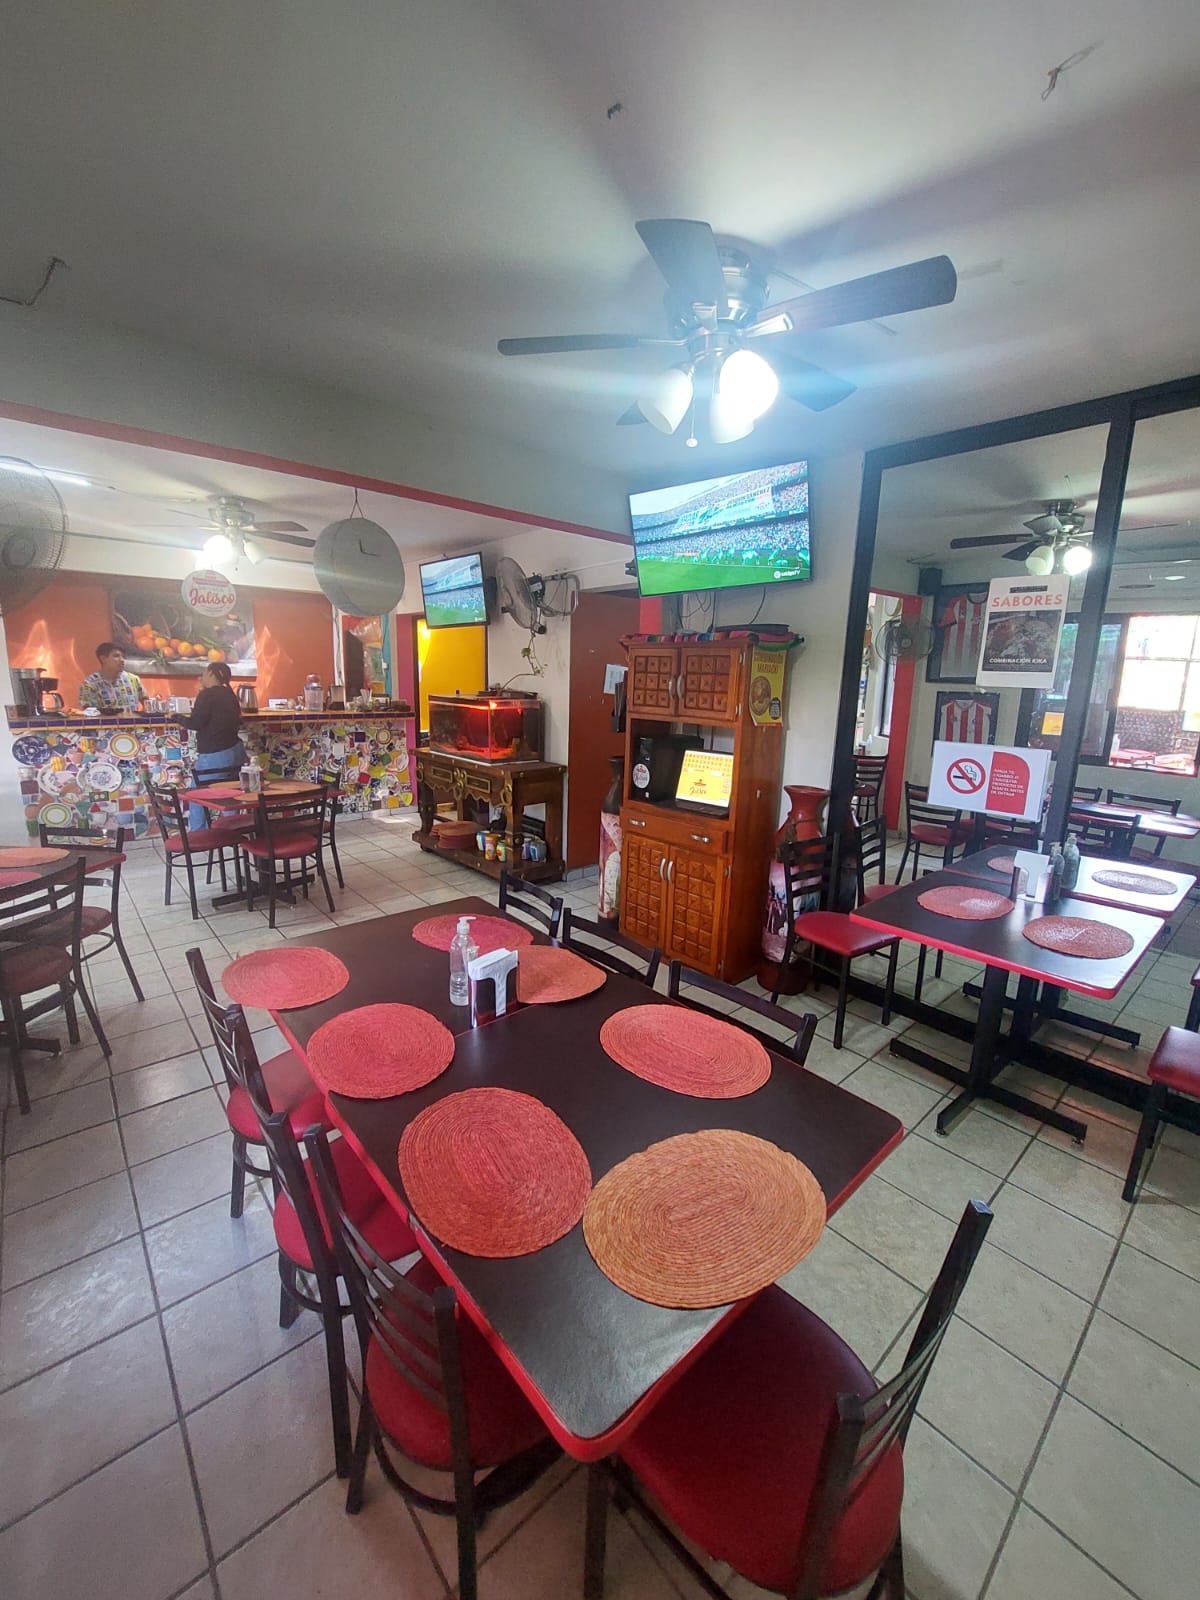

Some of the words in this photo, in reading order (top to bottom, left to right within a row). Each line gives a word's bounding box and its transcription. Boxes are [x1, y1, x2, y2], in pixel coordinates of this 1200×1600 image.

[189, 588, 234, 606] Jalisco
[991, 593, 1064, 608] SABORES
[988, 656, 1032, 664] COMBINACIÓN
